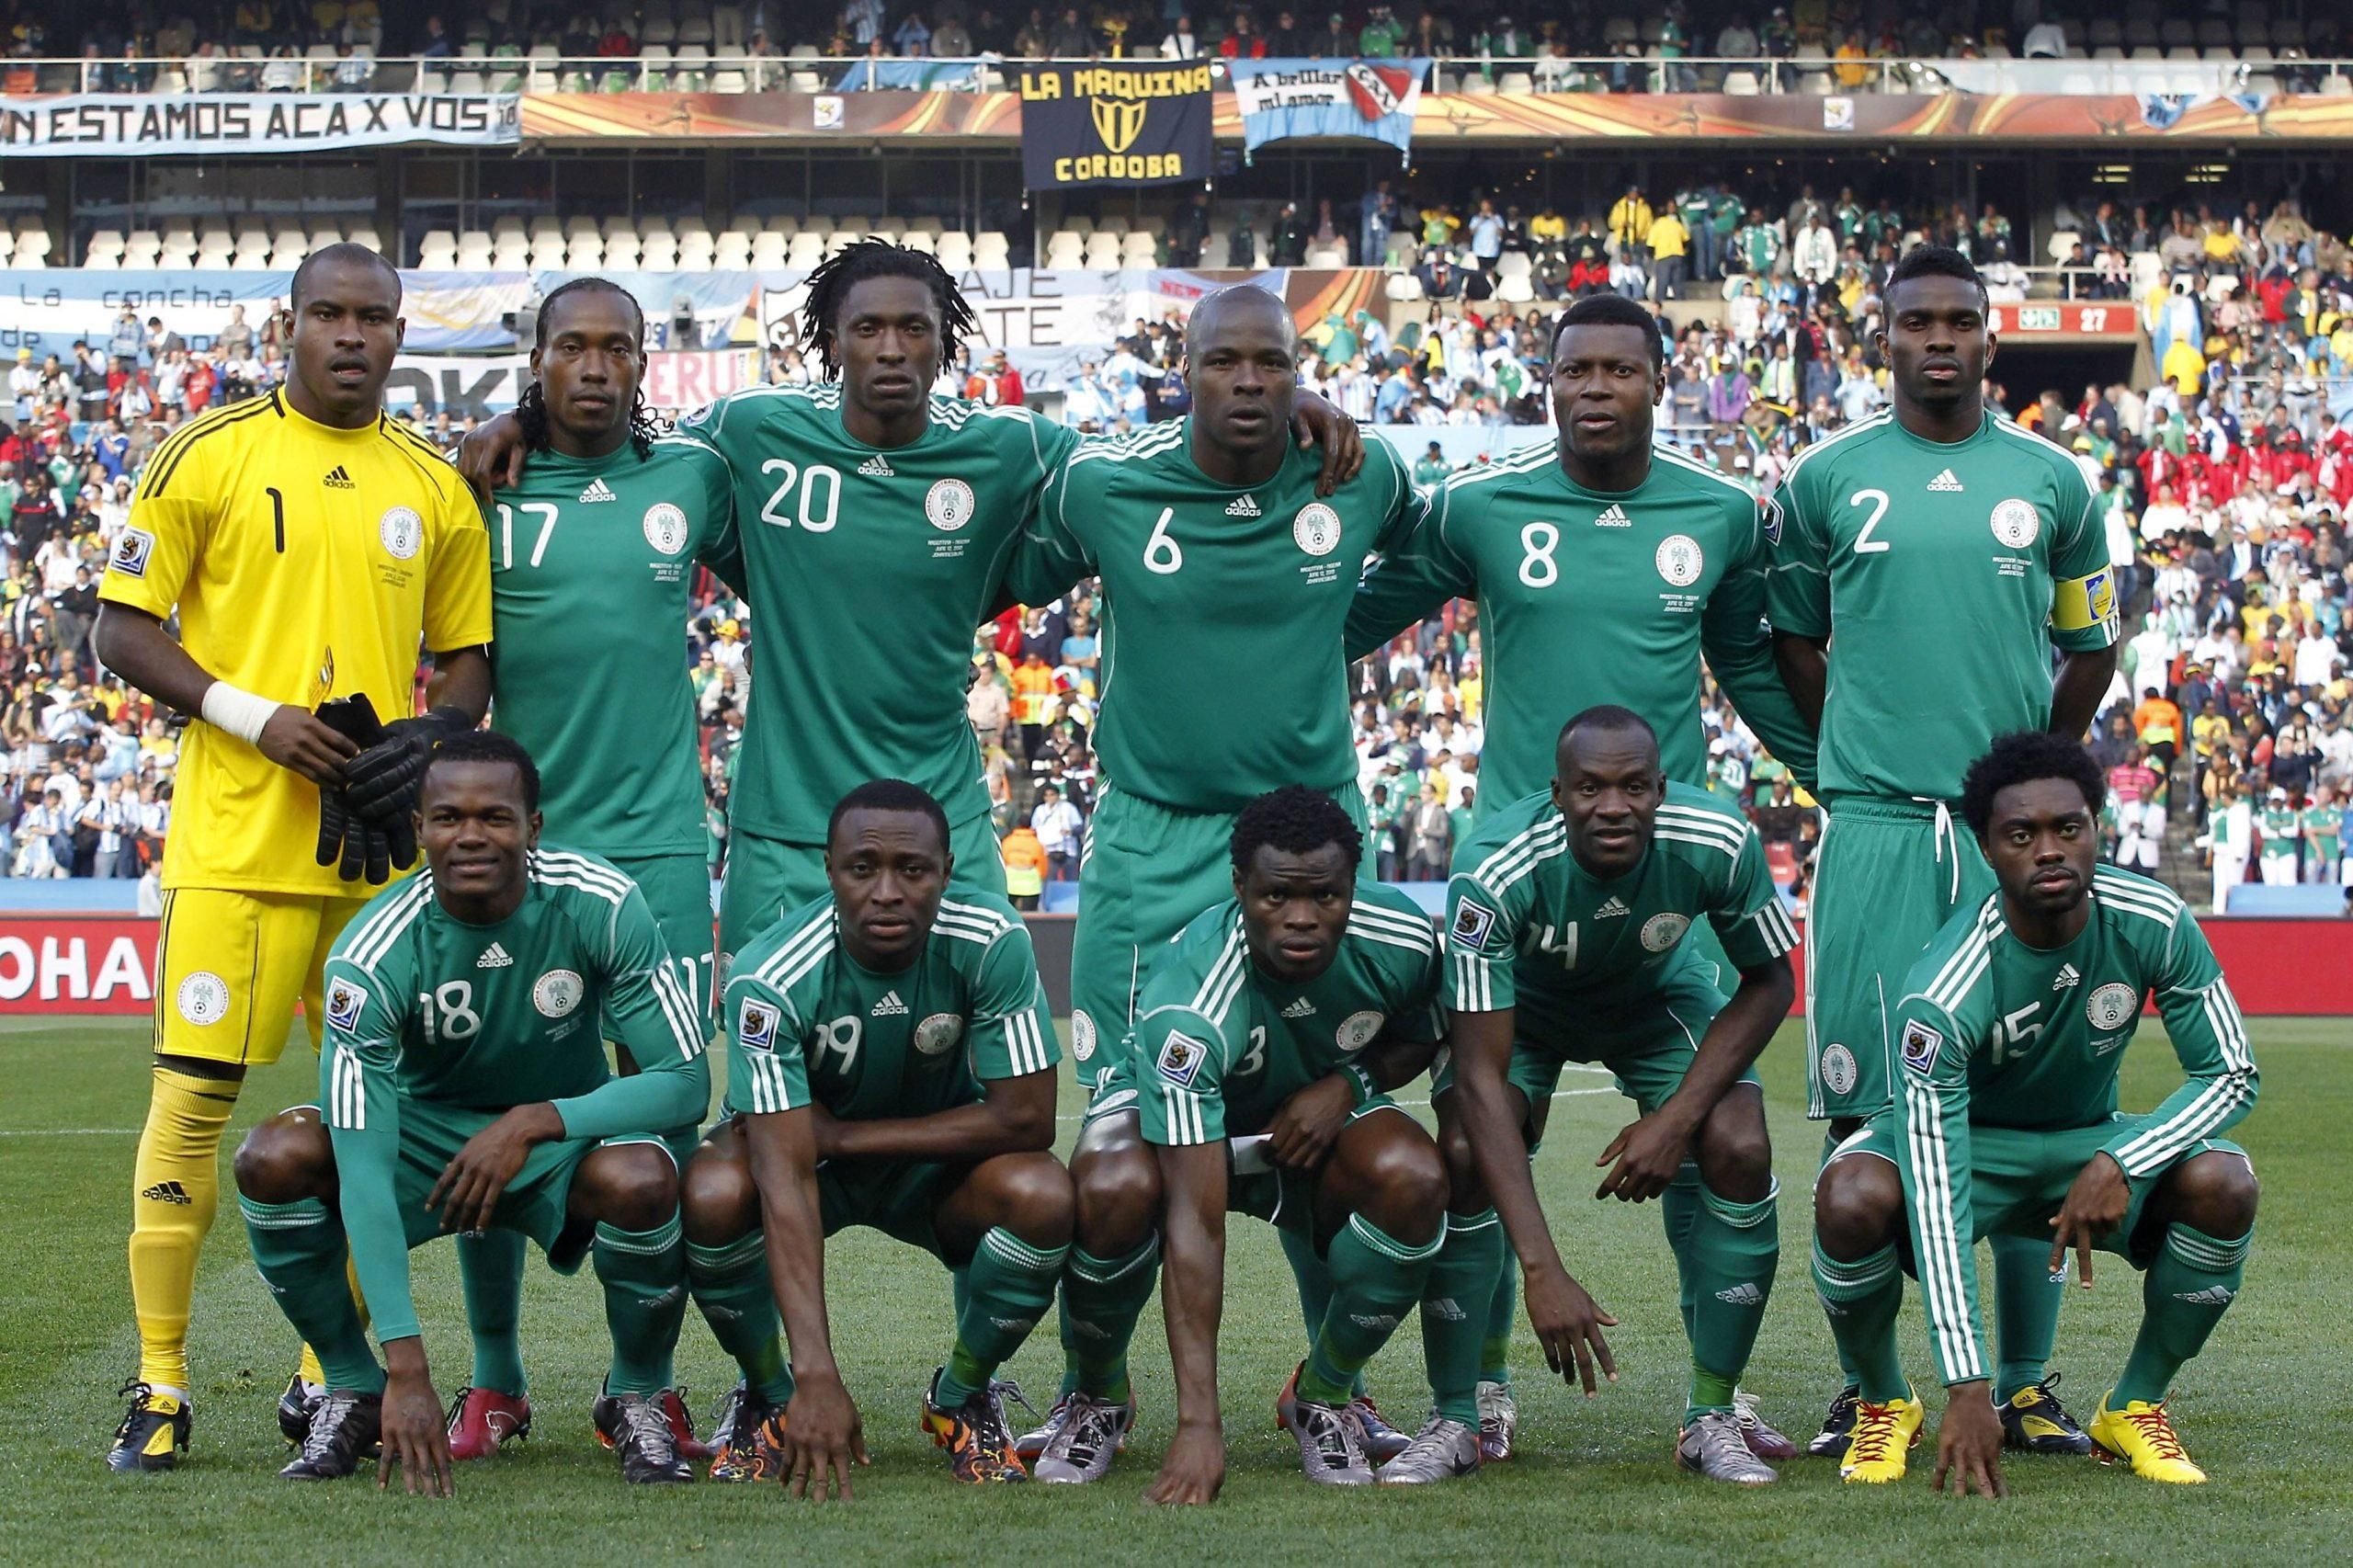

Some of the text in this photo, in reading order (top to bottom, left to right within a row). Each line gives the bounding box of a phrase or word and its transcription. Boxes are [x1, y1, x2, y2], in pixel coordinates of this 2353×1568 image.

[1021, 64, 1211, 101] LA MAQUINA
[1253, 73, 1268, 89] A
[1288, 92, 1336, 108] amor
[50, 103, 250, 143] ESTAMOS
[266, 102, 349, 139] ACA
[365, 97, 388, 131] X
[404, 96, 488, 131] VOS
[1055, 153, 1182, 182] CORDOBA
[20, 283, 233, 309] La concha
[2080, 308, 2108, 332] 27
[858, 465, 895, 477] adidas
[323, 479, 356, 490] adidas
[760, 458, 842, 533] 20
[1927, 483, 1963, 493] adidas
[579, 492, 617, 504] adidas
[266, 487, 285, 553] 1
[1224, 506, 1262, 517] adidas
[1595, 517, 1632, 528] adidas
[1850, 488, 1891, 554] 2
[496, 503, 559, 570] 17
[1143, 506, 1184, 575] 6
[1518, 521, 1560, 589] 8
[1593, 906, 1631, 920] adidas
[1522, 920, 1578, 971] 14
[476, 956, 514, 969] adidas
[419, 980, 483, 1045] 18
[870, 1006, 909, 1017] adidas
[1280, 1006, 1317, 1018] adidas
[810, 1015, 862, 1075] 19
[1992, 1000, 2044, 1065] 15
[142, 1187, 192, 1206] adidas
